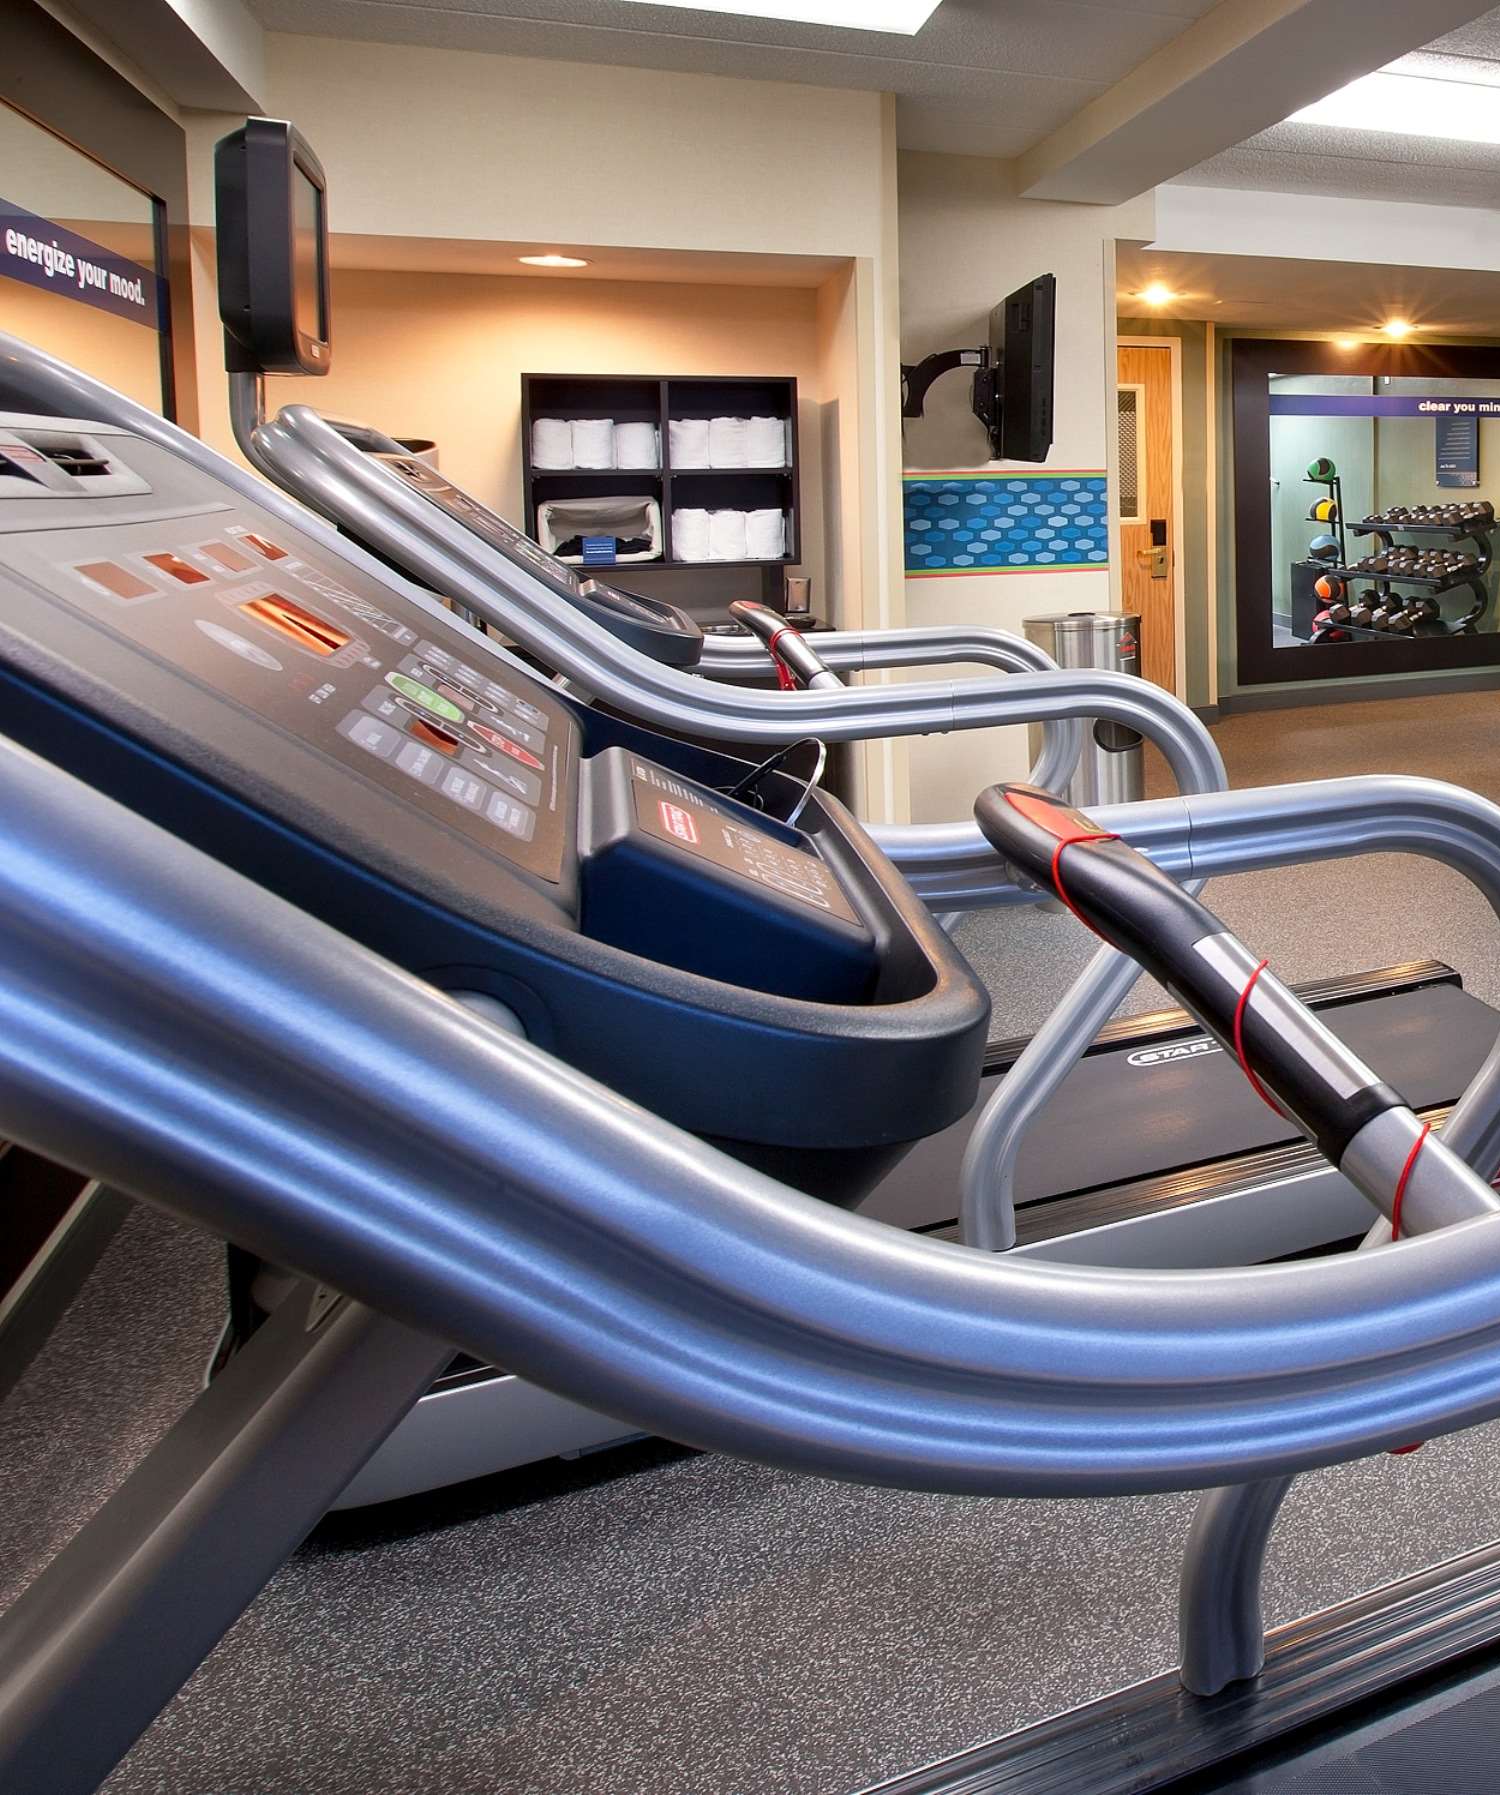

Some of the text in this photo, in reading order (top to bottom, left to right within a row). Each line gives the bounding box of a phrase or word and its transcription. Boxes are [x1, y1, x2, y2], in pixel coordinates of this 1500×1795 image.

[5, 228, 145, 306] energize your mood.
[1418, 400, 1452, 411] clear
[1454, 403, 1476, 414] you
[1140, 1043, 1209, 1062] STAR
